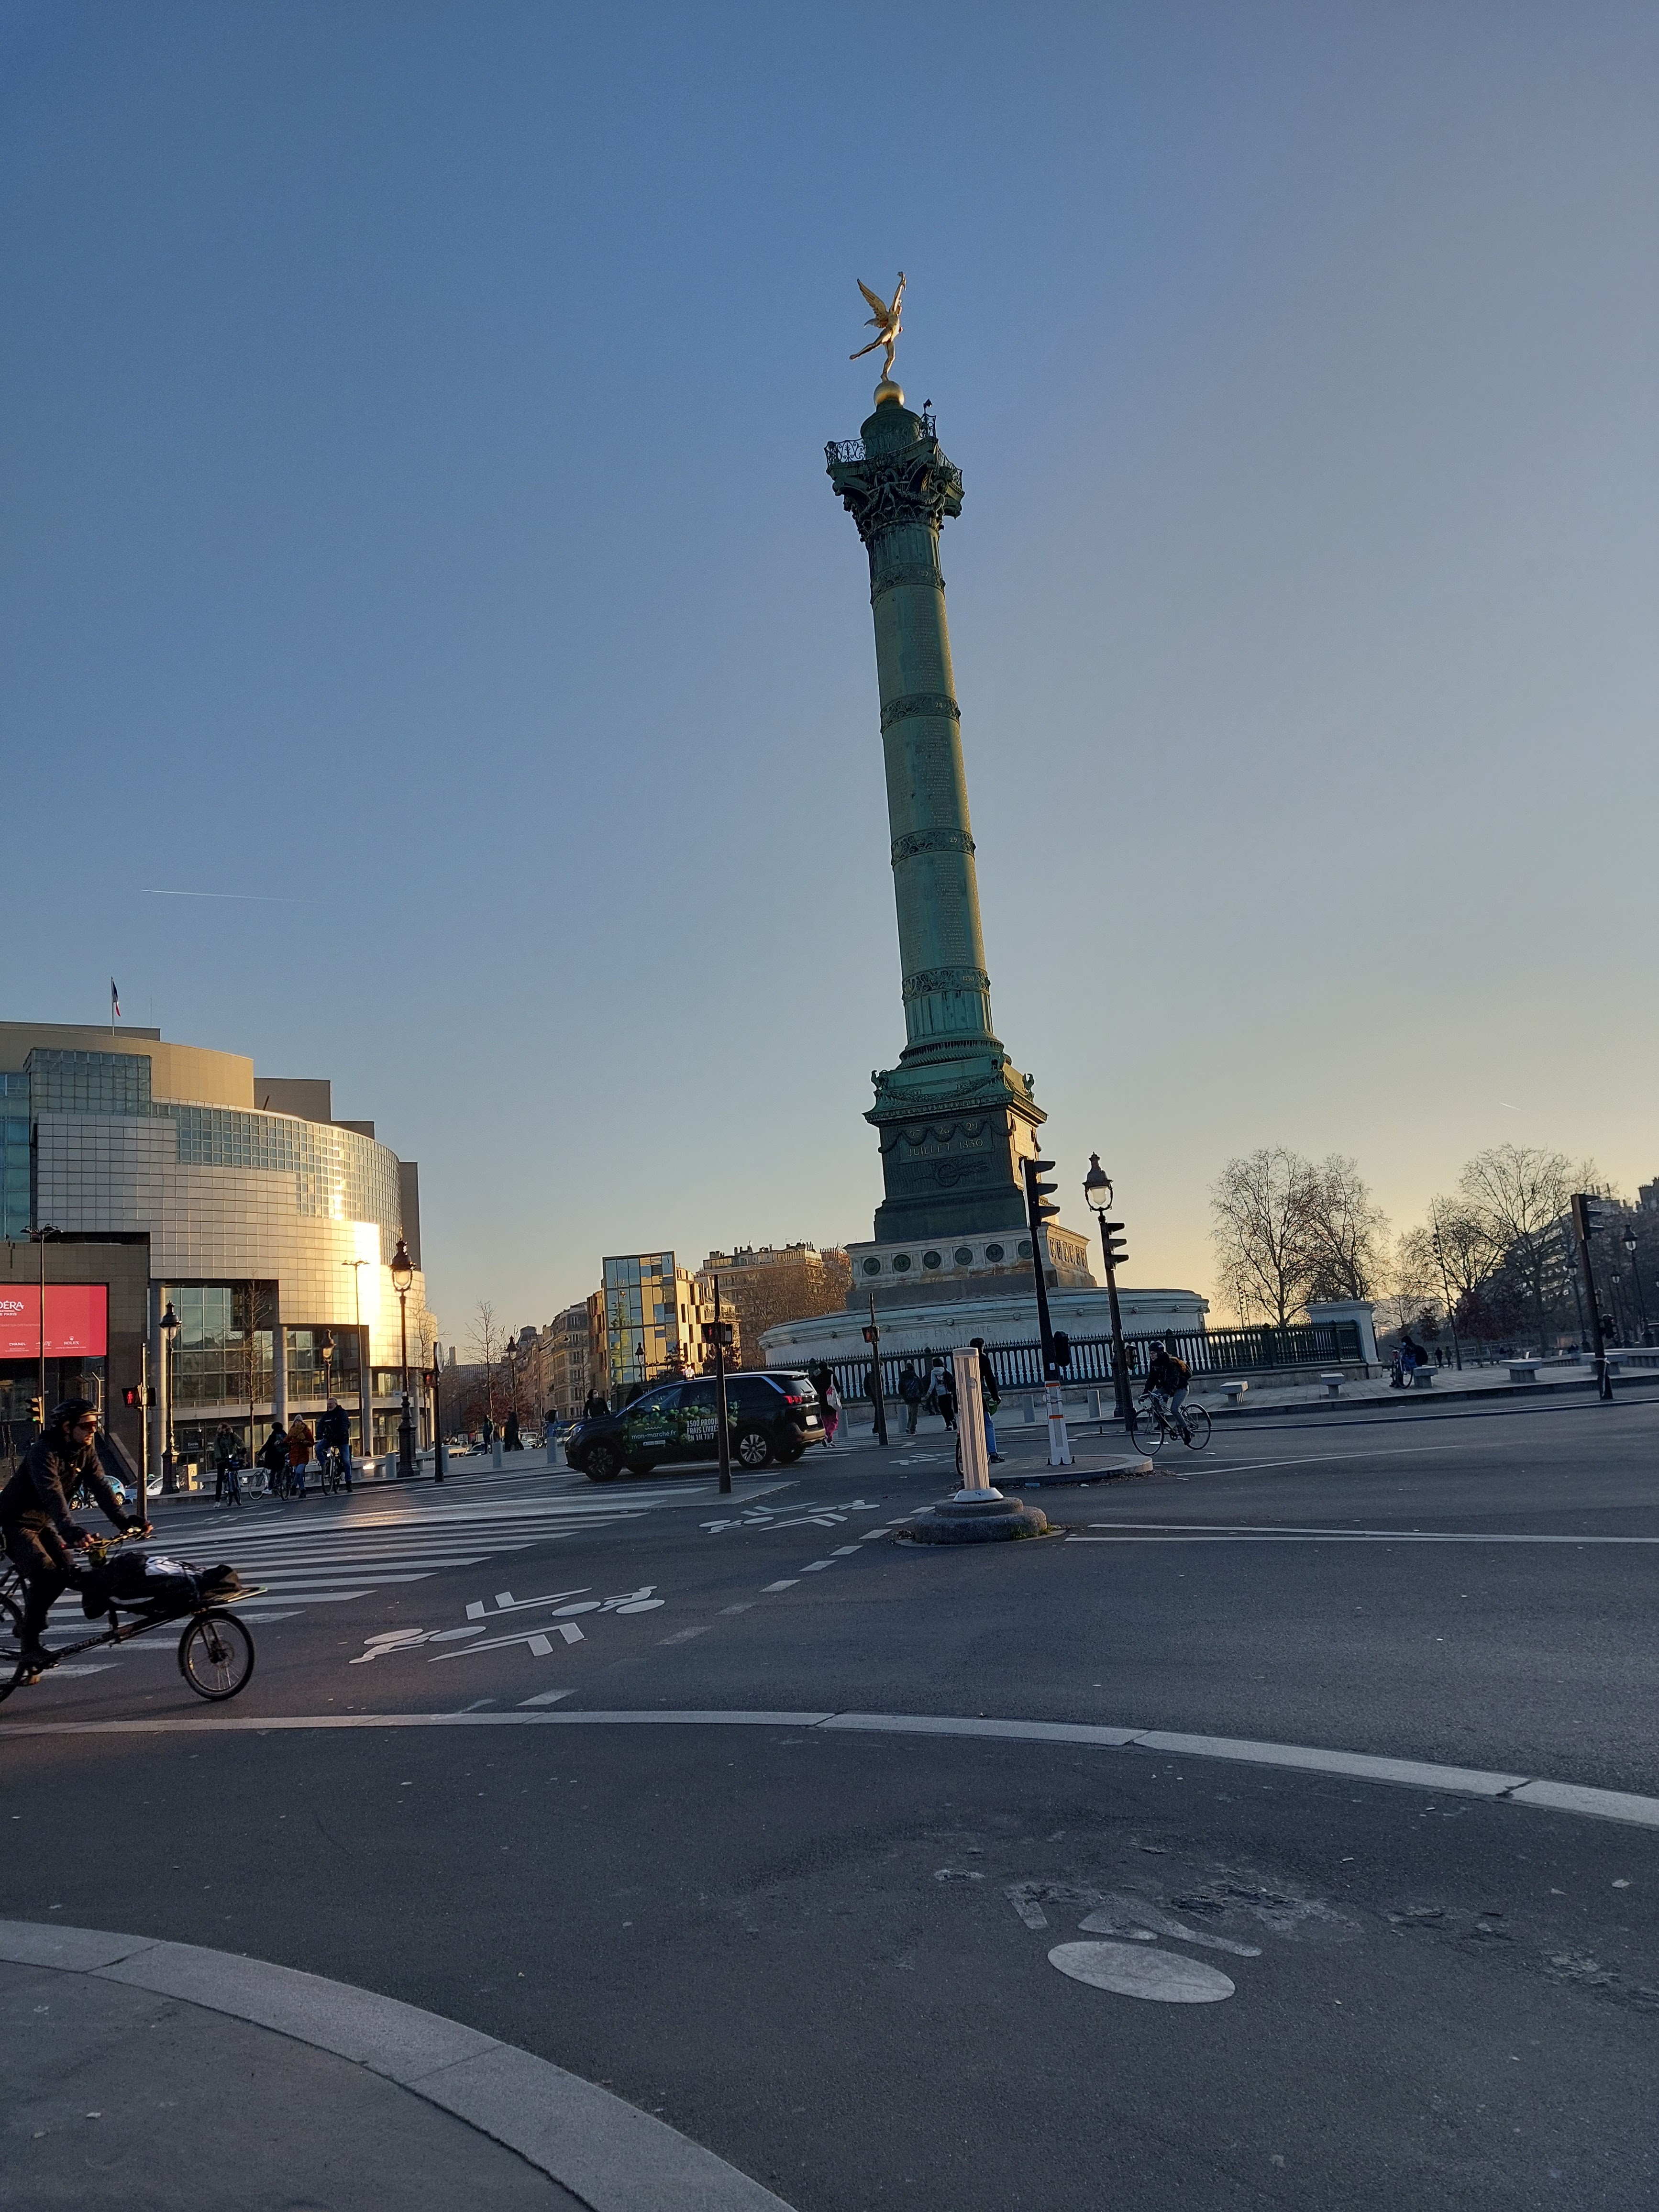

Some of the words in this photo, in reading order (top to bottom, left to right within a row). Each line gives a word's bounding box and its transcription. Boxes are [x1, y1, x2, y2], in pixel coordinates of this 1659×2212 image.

[966, 1122, 978, 1131] 29
[907, 1143, 950, 1157] JUILLET
[960, 1139, 983, 1150] 1830
[934, 1326, 992, 1338] FRATERNITE
[700, 1417, 718, 1426] PRODU
[631, 1429, 676, 1439] mon-marché.fr
[686, 1427, 702, 1435] FRAIS
